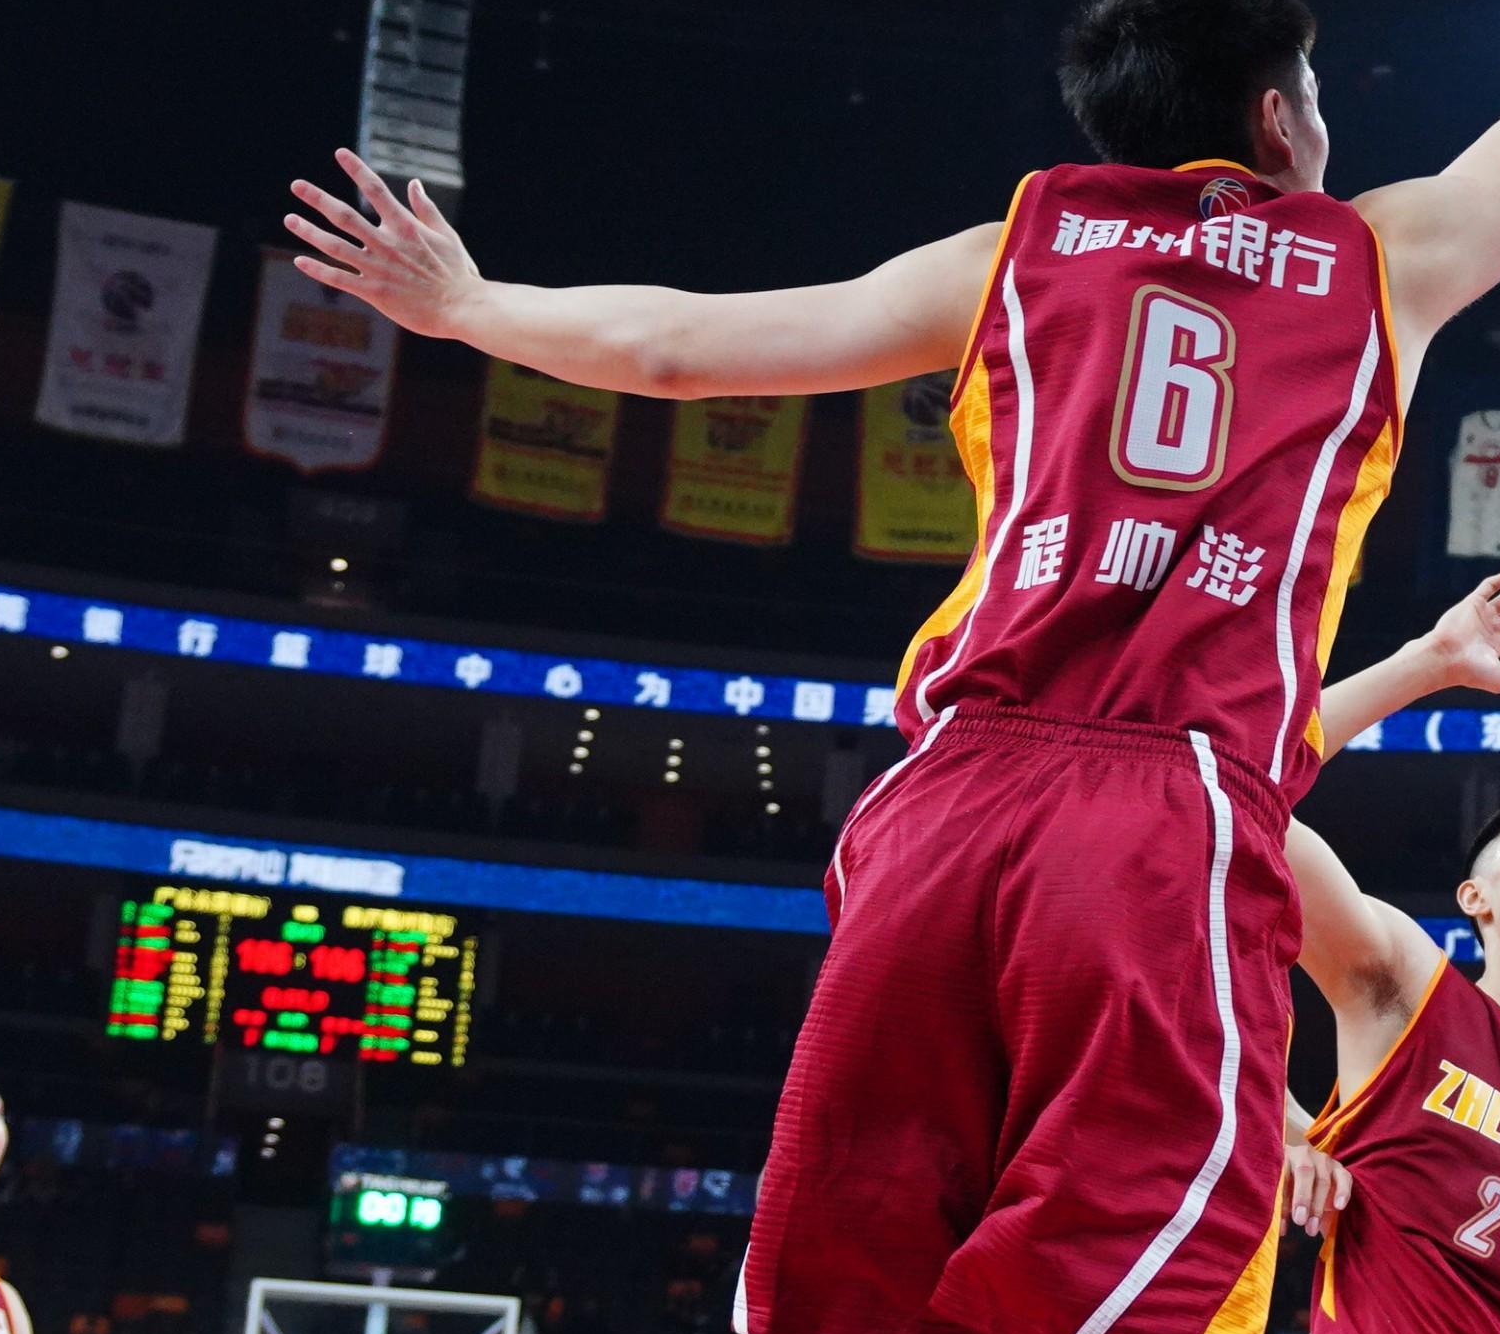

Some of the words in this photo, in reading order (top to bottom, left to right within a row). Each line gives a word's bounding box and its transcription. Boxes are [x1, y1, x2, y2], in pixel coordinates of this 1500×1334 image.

[1052, 209, 1337, 297] 稠州银行
[1109, 284, 1236, 492] 6
[1013, 513, 1266, 607] 程帅澎
